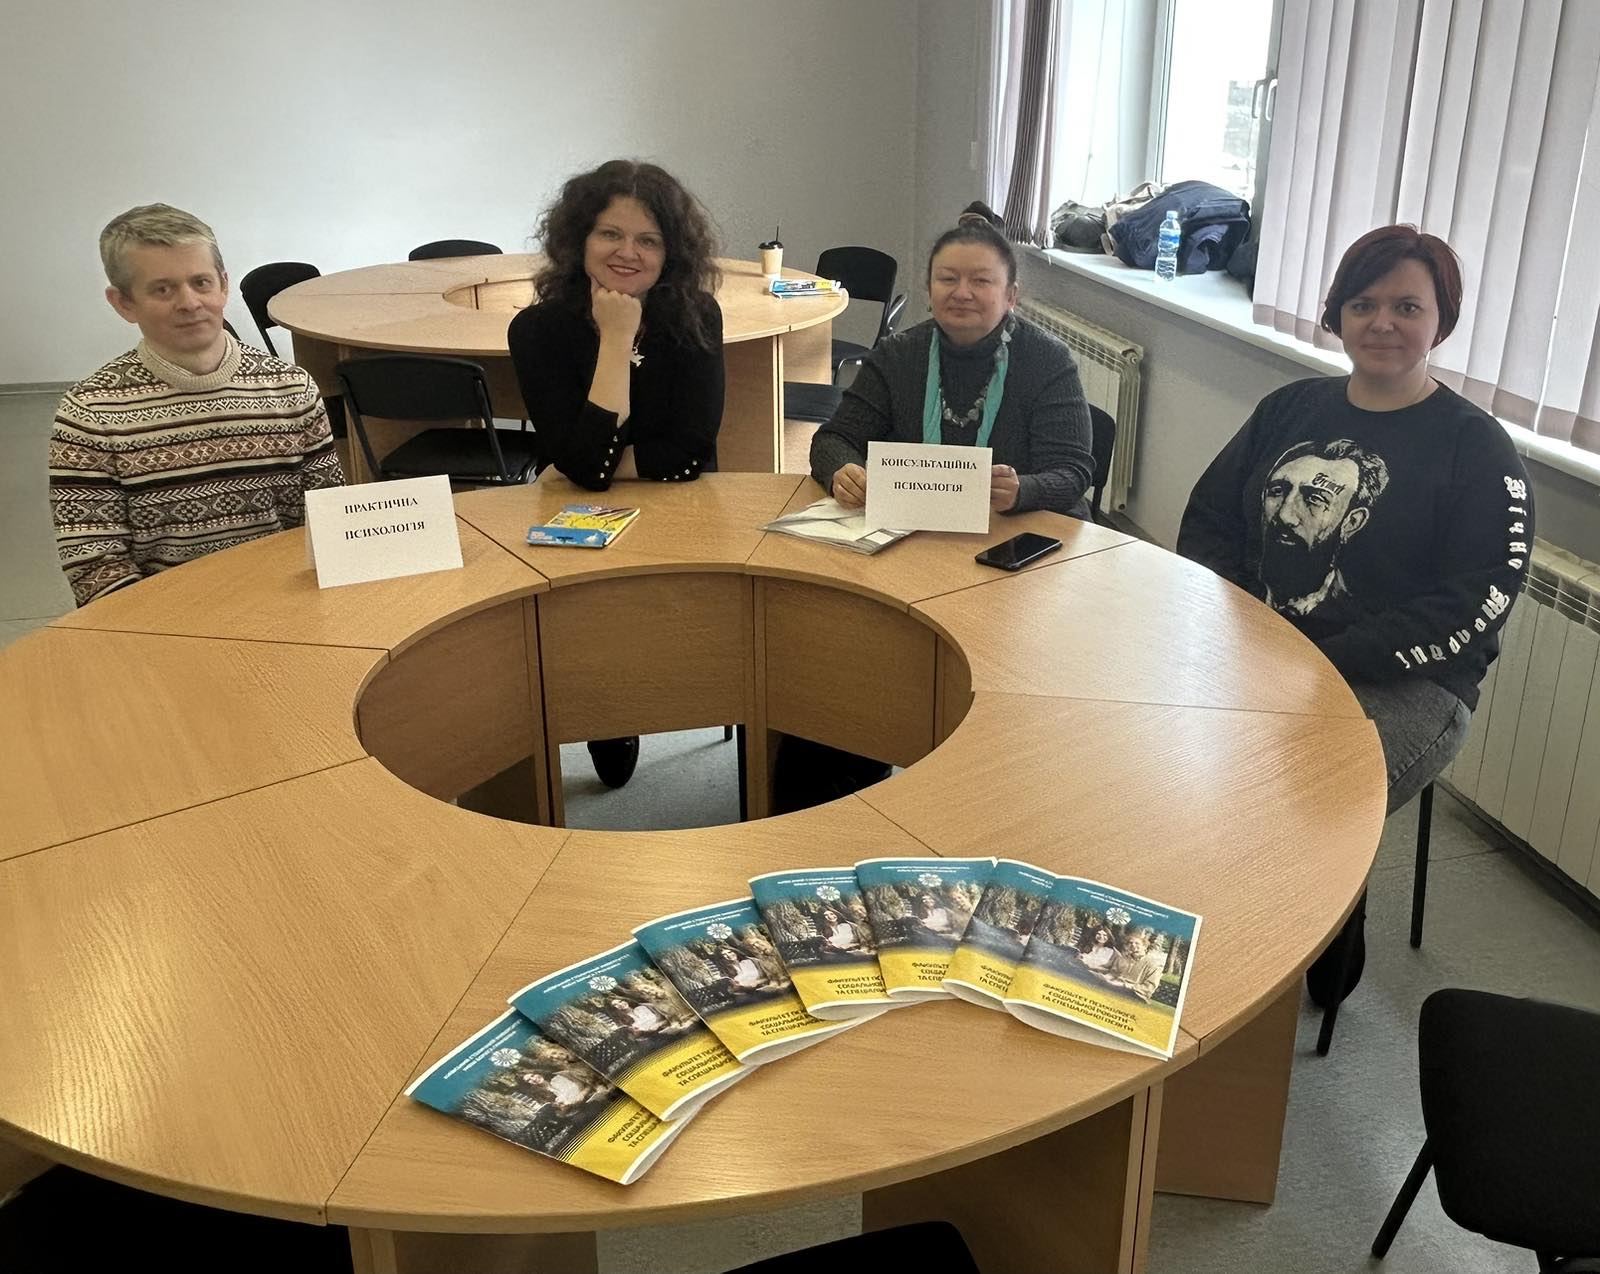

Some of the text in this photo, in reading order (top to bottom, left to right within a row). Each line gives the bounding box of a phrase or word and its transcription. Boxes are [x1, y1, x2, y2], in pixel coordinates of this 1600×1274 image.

[881, 457, 977, 470] КОНСУЛЬТАЦІЙНА
[894, 481, 963, 493] ПСИХОЛОГІЯ
[344, 497, 418, 515] ПРАКТИЧНА
[344, 521, 426, 540] ПСИХОЛОГІЯ
